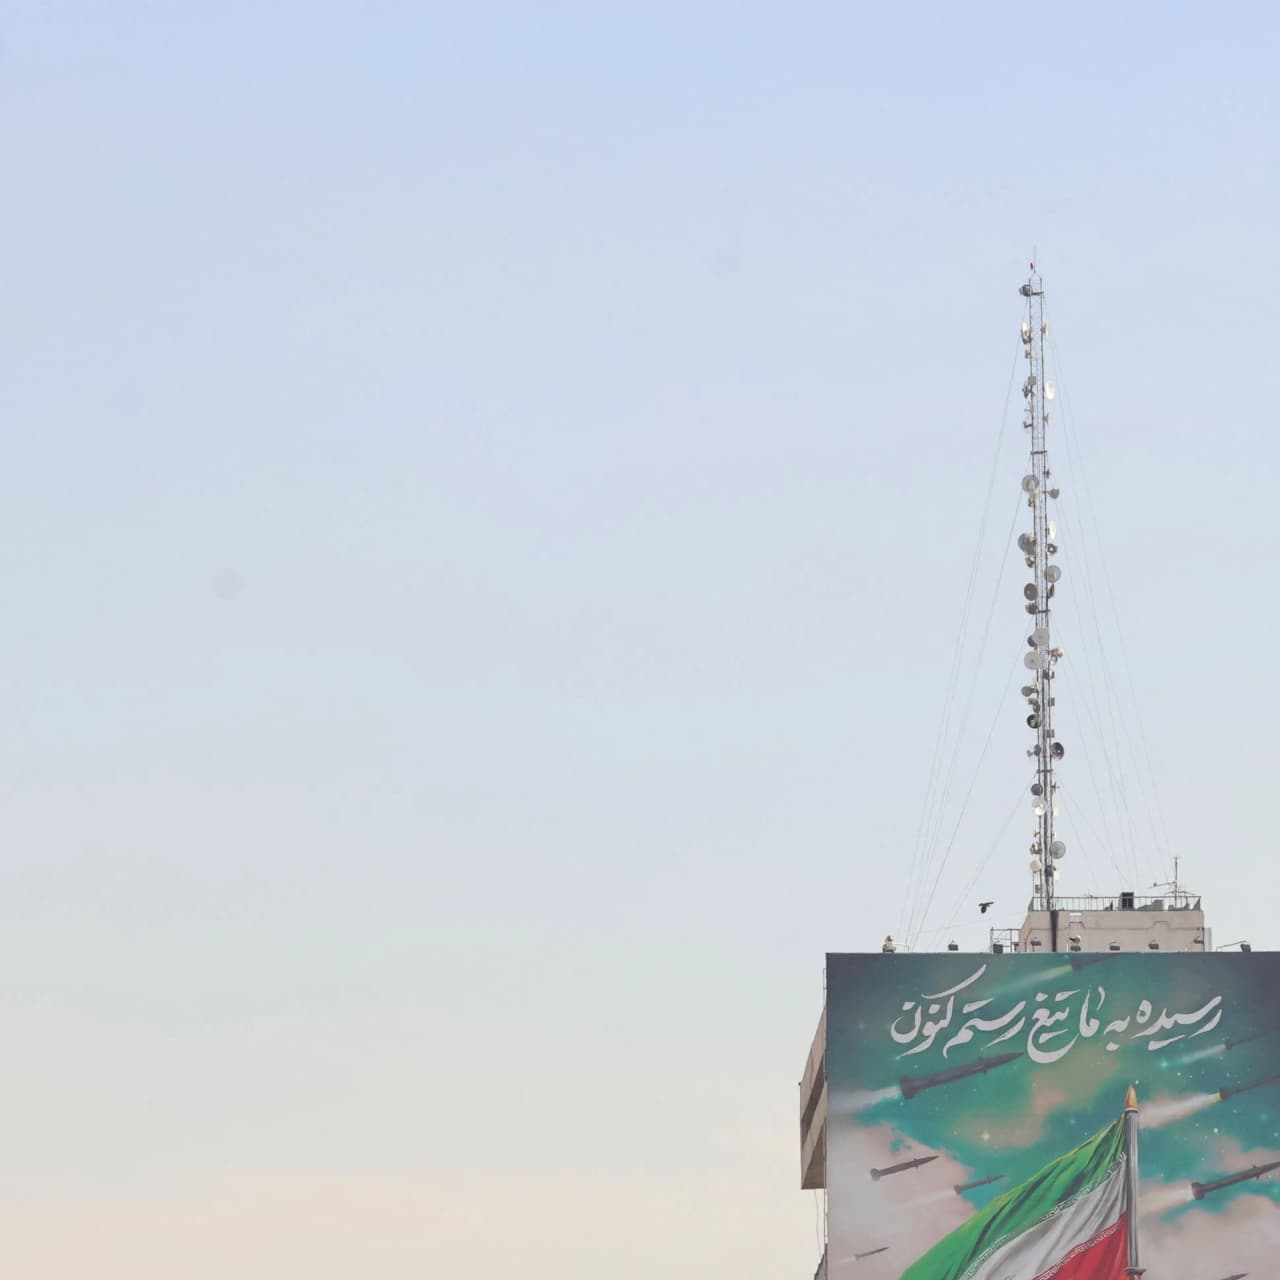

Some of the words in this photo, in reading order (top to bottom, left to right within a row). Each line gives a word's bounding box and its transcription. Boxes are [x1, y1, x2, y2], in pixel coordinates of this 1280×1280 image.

[889, 962, 988, 1061] کنون
[942, 996, 1028, 1059] رستم
[1105, 1006, 1133, 1053] به
[1134, 994, 1223, 1052] رسیده
